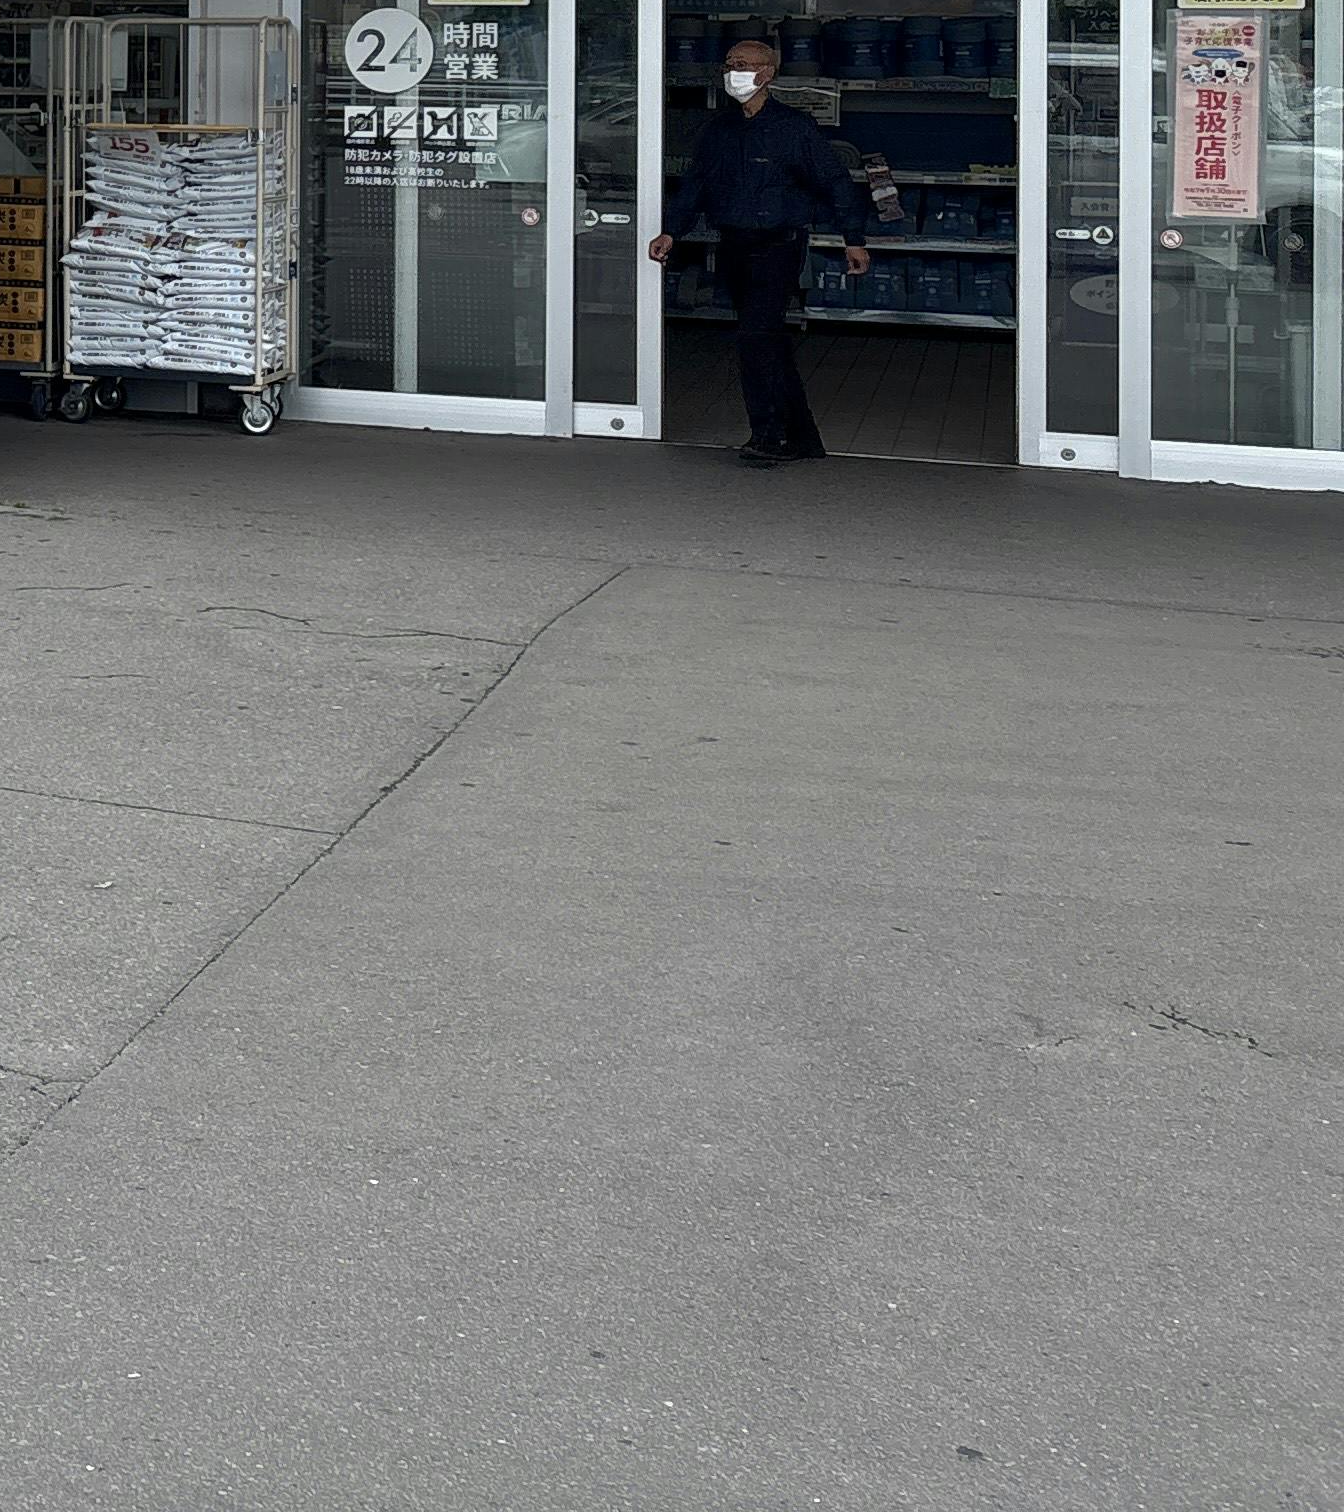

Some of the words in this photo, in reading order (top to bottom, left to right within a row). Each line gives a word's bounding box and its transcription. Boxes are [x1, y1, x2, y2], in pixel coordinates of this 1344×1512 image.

[355, 25, 423, 73] 24
[443, 22, 499, 49] 時間
[443, 53, 499, 80] 営業
[109, 137, 150, 154] 155
[1194, 89, 1228, 180] 取扱店舗
